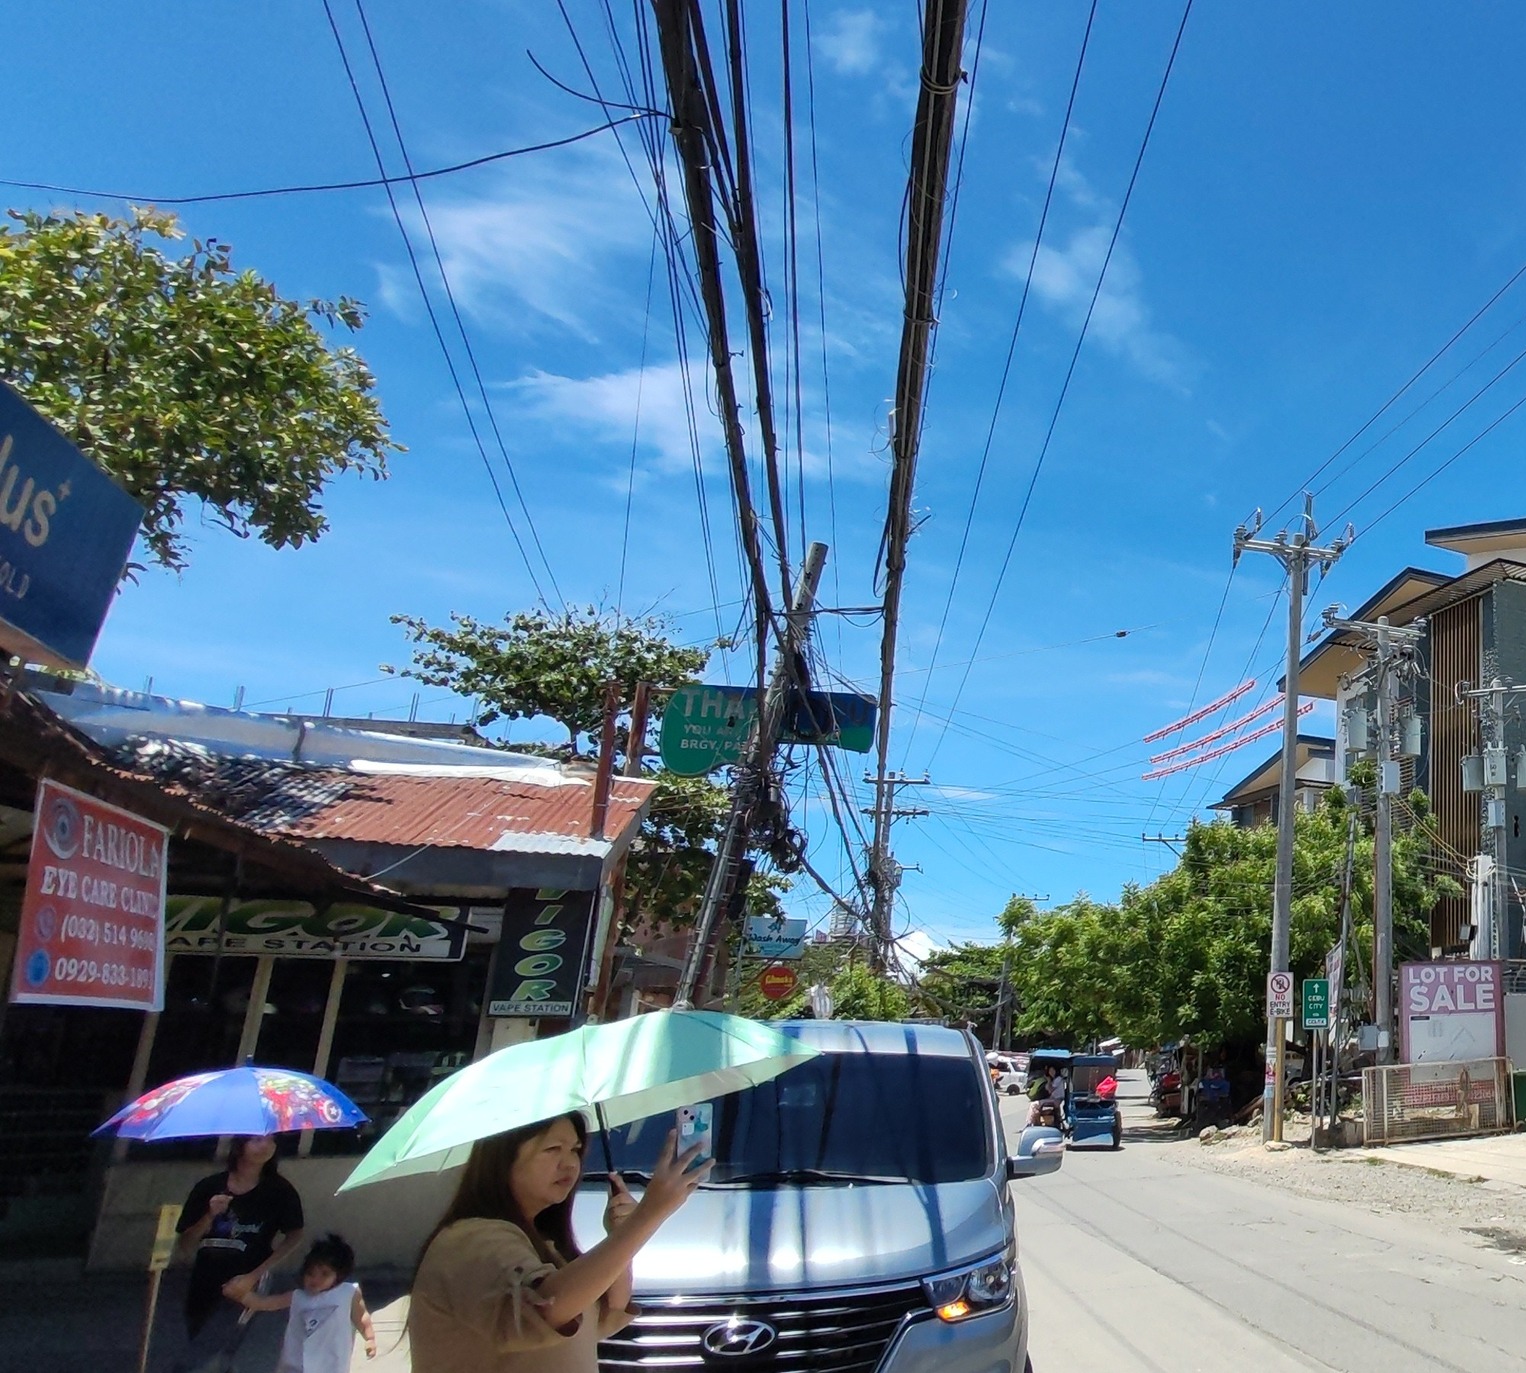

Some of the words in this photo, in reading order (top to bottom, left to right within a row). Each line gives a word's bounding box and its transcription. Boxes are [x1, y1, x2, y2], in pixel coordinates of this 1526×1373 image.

[681, 688, 757, 719] THA
[81, 814, 160, 878] FARIOLA
[40, 866, 78, 899] EYE
[81, 875, 117, 909] CARE
[60, 913, 99, 947] (032)
[104, 922, 126, 945] 514
[263, 935, 421, 953] STATION
[1409, 967, 1448, 984] LOT
[1453, 966, 1494, 983] FOR
[493, 1003, 521, 1012] VAPE
[524, 1003, 569, 1013] STATION
[1270, 1008, 1291, 1016] E-BIKE
[1409, 983, 1496, 1012] SALE
